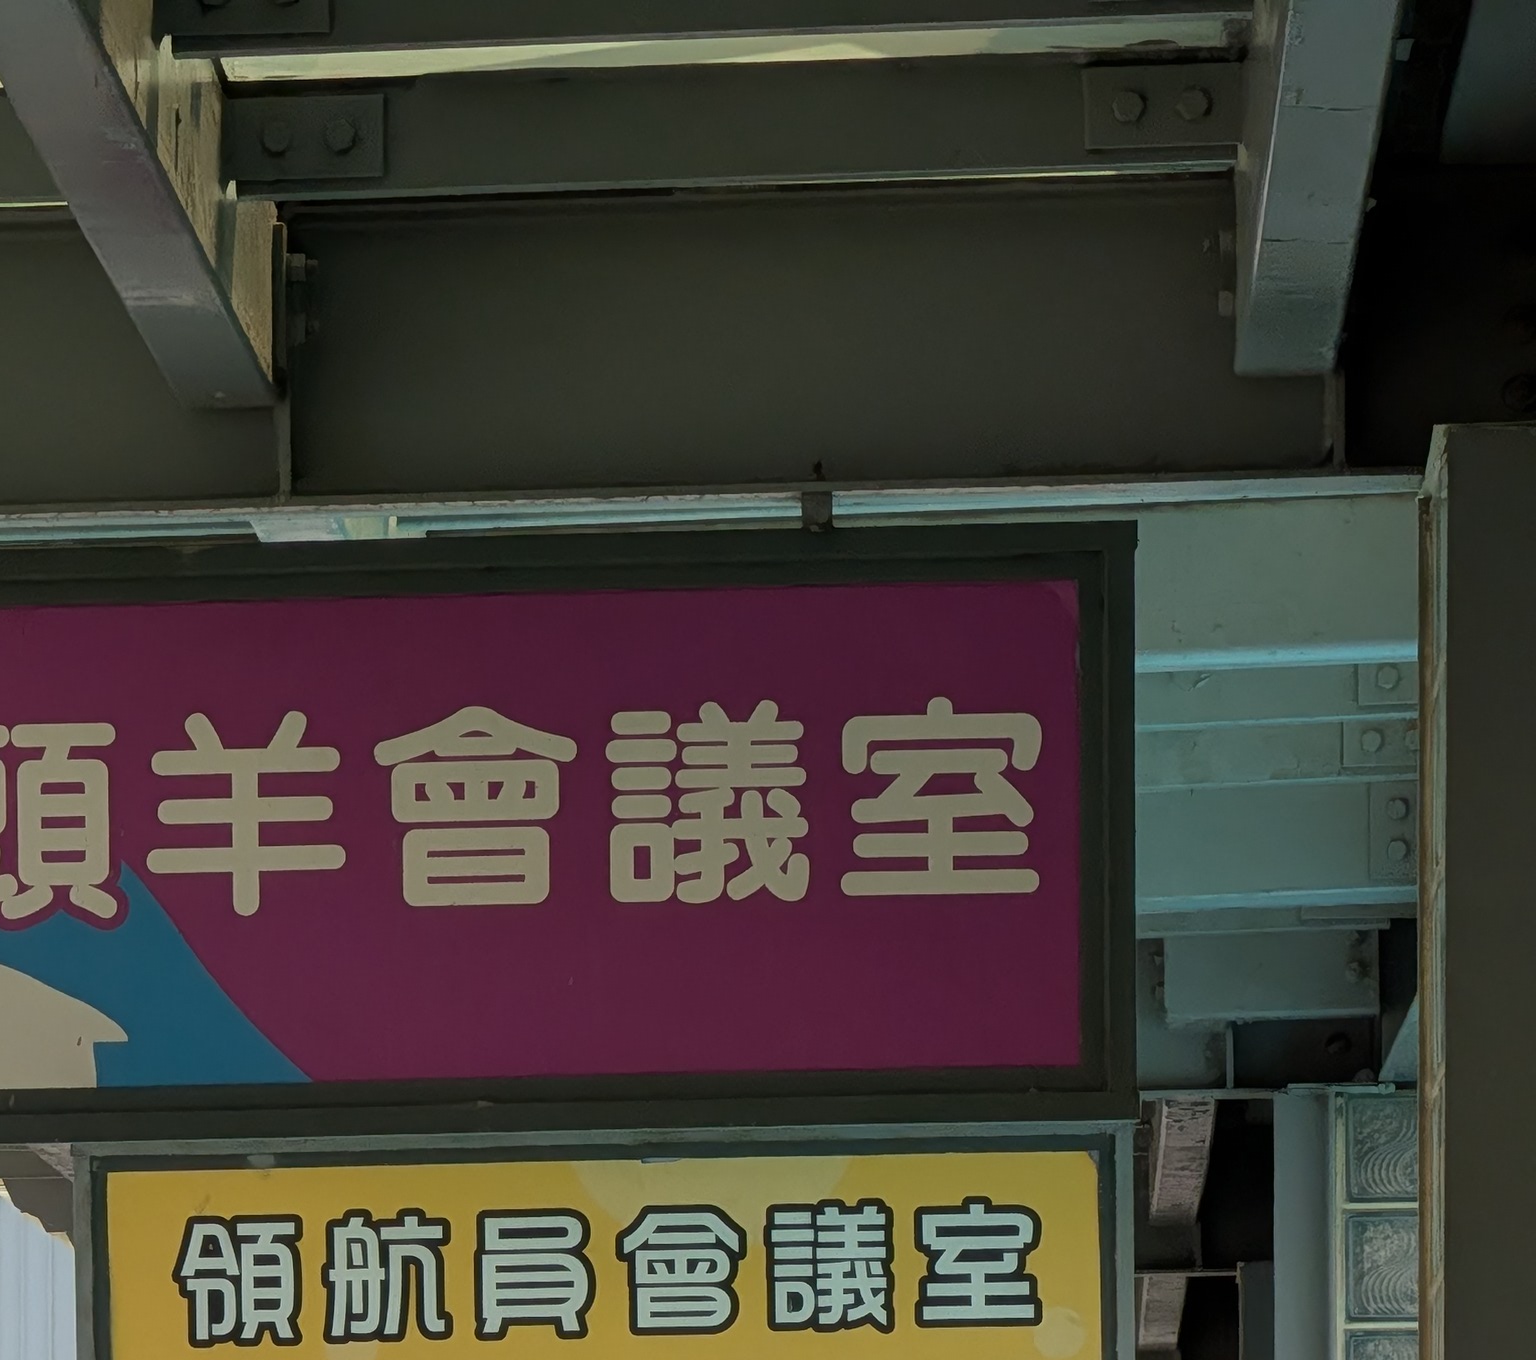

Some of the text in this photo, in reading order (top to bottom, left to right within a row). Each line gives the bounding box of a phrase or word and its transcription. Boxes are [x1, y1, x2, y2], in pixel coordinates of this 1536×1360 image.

[175, 1199, 1043, 1346] 領航員會議室
